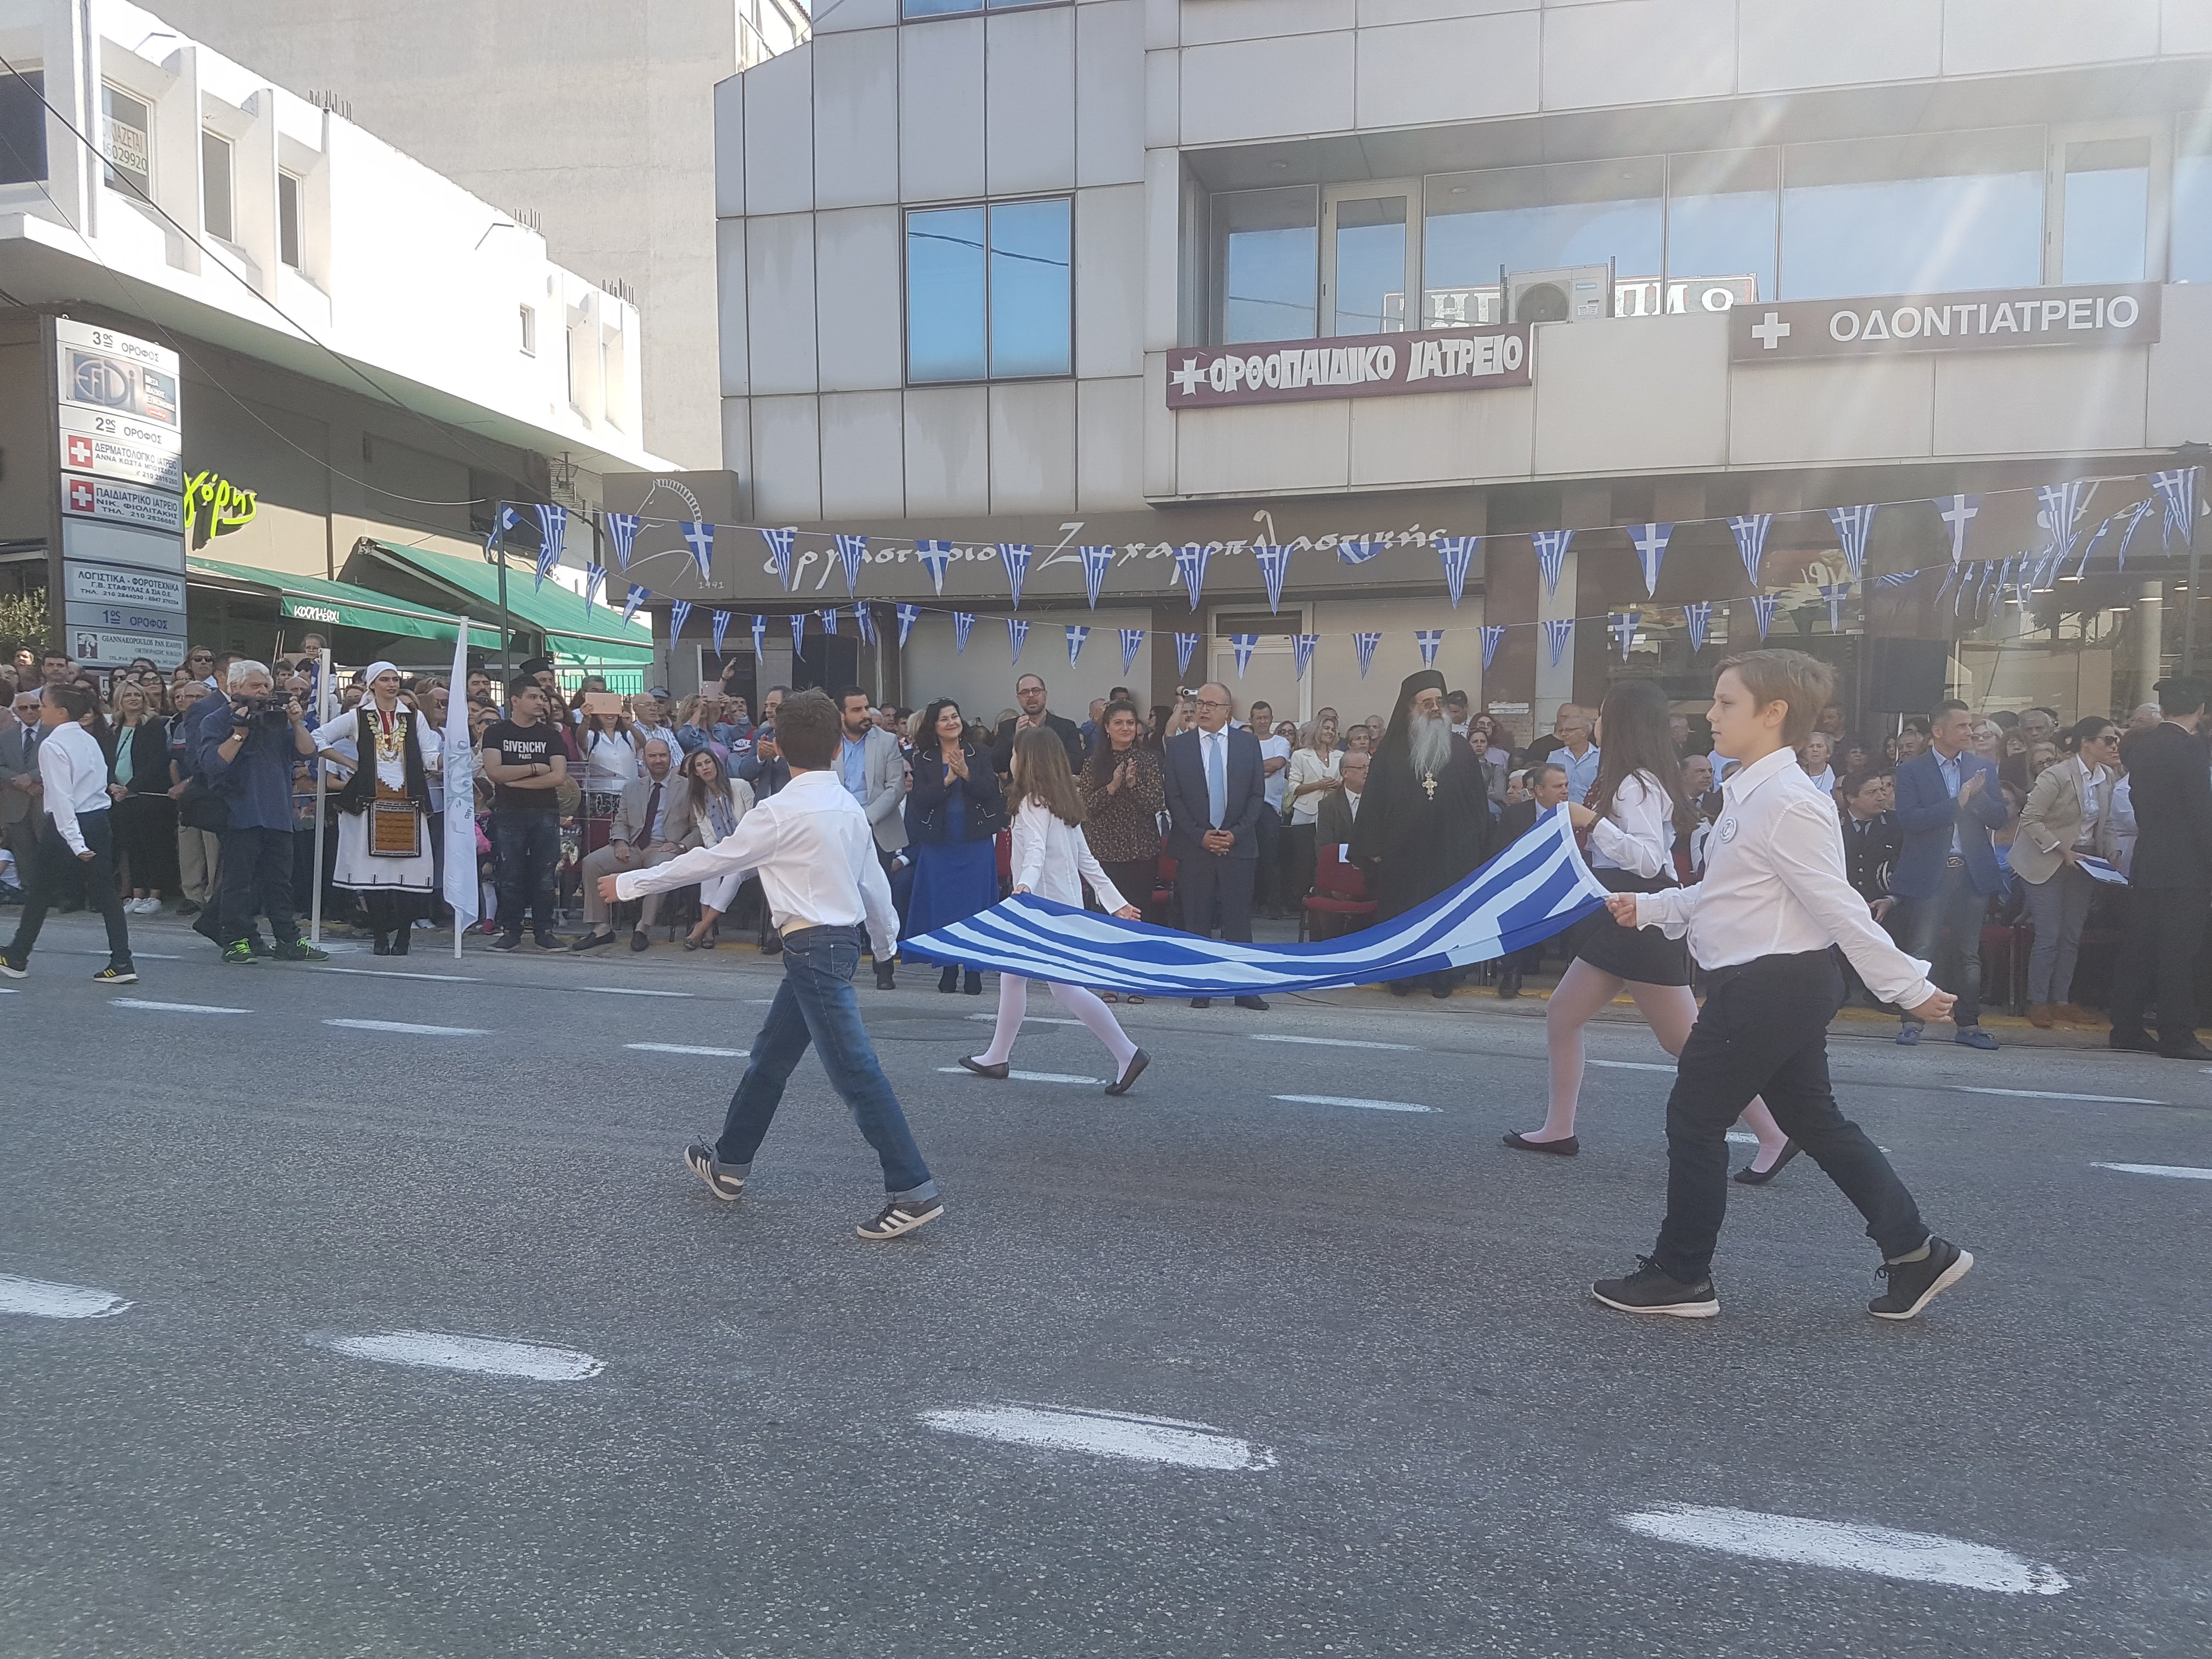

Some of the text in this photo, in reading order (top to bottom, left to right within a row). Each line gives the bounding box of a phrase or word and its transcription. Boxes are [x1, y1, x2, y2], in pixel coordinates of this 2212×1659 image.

[1829, 296, 2140, 342] ΟΔΟΝΤΙΑΤΡΕΙΟ
[122, 342, 159, 362] ΟΡΟΦΟΣ
[1209, 334, 1523, 393] ΟΡΘΟΠΑΙΔΙΚΟ ΙΑΤΡΕΙΟ
[124, 426, 162, 444] ΟΡΟΦΟΣ
[95, 443, 177, 470] ΔΕΡΜΑΤΟΛΟΓΙΚΟ ΙΑΤΡΕΙΟ
[95, 453, 116, 462] ΑΝΝΑ
[119, 458, 142, 467] ΚΩΣΤΑ
[96, 487, 178, 512] ΠΑΙΔΙΑΤΡΙΚΟ ΙΑΤΡΕΙΟ
[96, 498, 178, 519] ΝΙΚ. ΦΙΟΛΙΤΑΚΗΣ
[101, 506, 125, 515] ΤΗΛ.
[78, 571, 125, 584] ΛΟΓΙΣΤΙΚΑ
[132, 578, 179, 592] ΦΟΡΟΤΕΧΝΙΚΑ
[108, 583, 144, 593] ΣΤΑΦΥΛΑΣ
[130, 616, 167, 629] ΟΡΟΦΟΣ
[102, 635, 153, 646] GIANNAKOPOULOS
[503, 740, 547, 753] GIVENCHY
